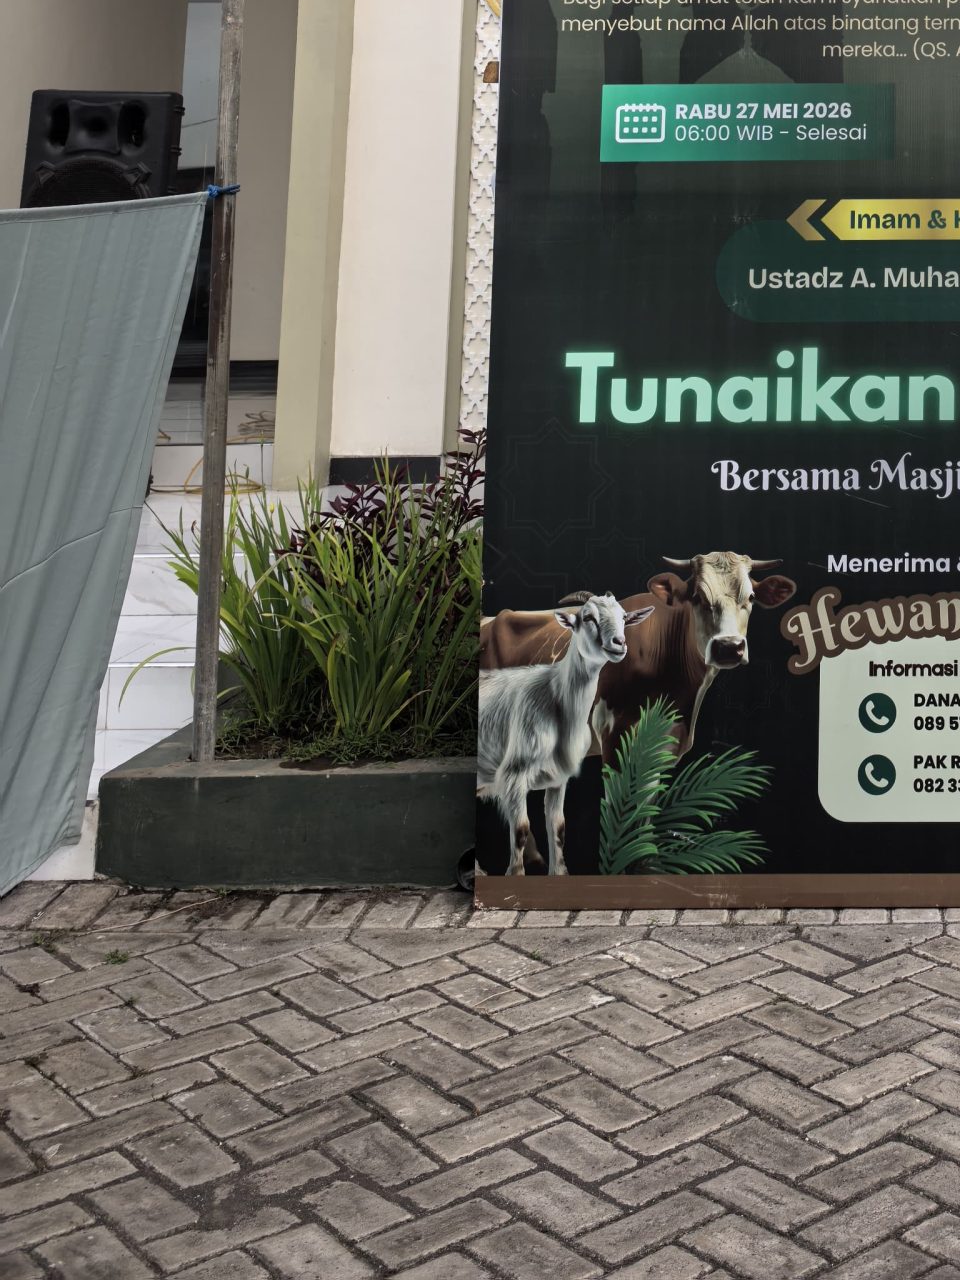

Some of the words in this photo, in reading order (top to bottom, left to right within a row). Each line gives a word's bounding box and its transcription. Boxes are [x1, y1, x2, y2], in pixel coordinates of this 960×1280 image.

[561, 15, 663, 36] menyebut
[667, 18, 726, 31] nama
[731, 14, 778, 31] Allah
[784, 16, 826, 30] atas
[832, 14, 919, 36] binatang
[822, 41, 907, 57] mereka...
[913, 37, 951, 61] (QS.
[675, 103, 731, 120] RABU
[735, 102, 759, 119] 27
[763, 103, 798, 119] MEI
[803, 102, 852, 119] 2026
[674, 124, 730, 142] 06:00
[736, 125, 773, 141] WIB
[796, 123, 867, 141] Selesai
[850, 210, 921, 230] Imam
[927, 209, 947, 230] &
[749, 266, 844, 289] Ustadz
[850, 267, 876, 288] A.
[562, 345, 957, 425] Tunaikan
[710, 459, 861, 491] Bersama
[827, 551, 951, 573] Menerima
[868, 659, 959, 677] Informasi
[913, 715, 945, 731] 089
[913, 754, 948, 770] PAK
[913, 777, 945, 793] 082
